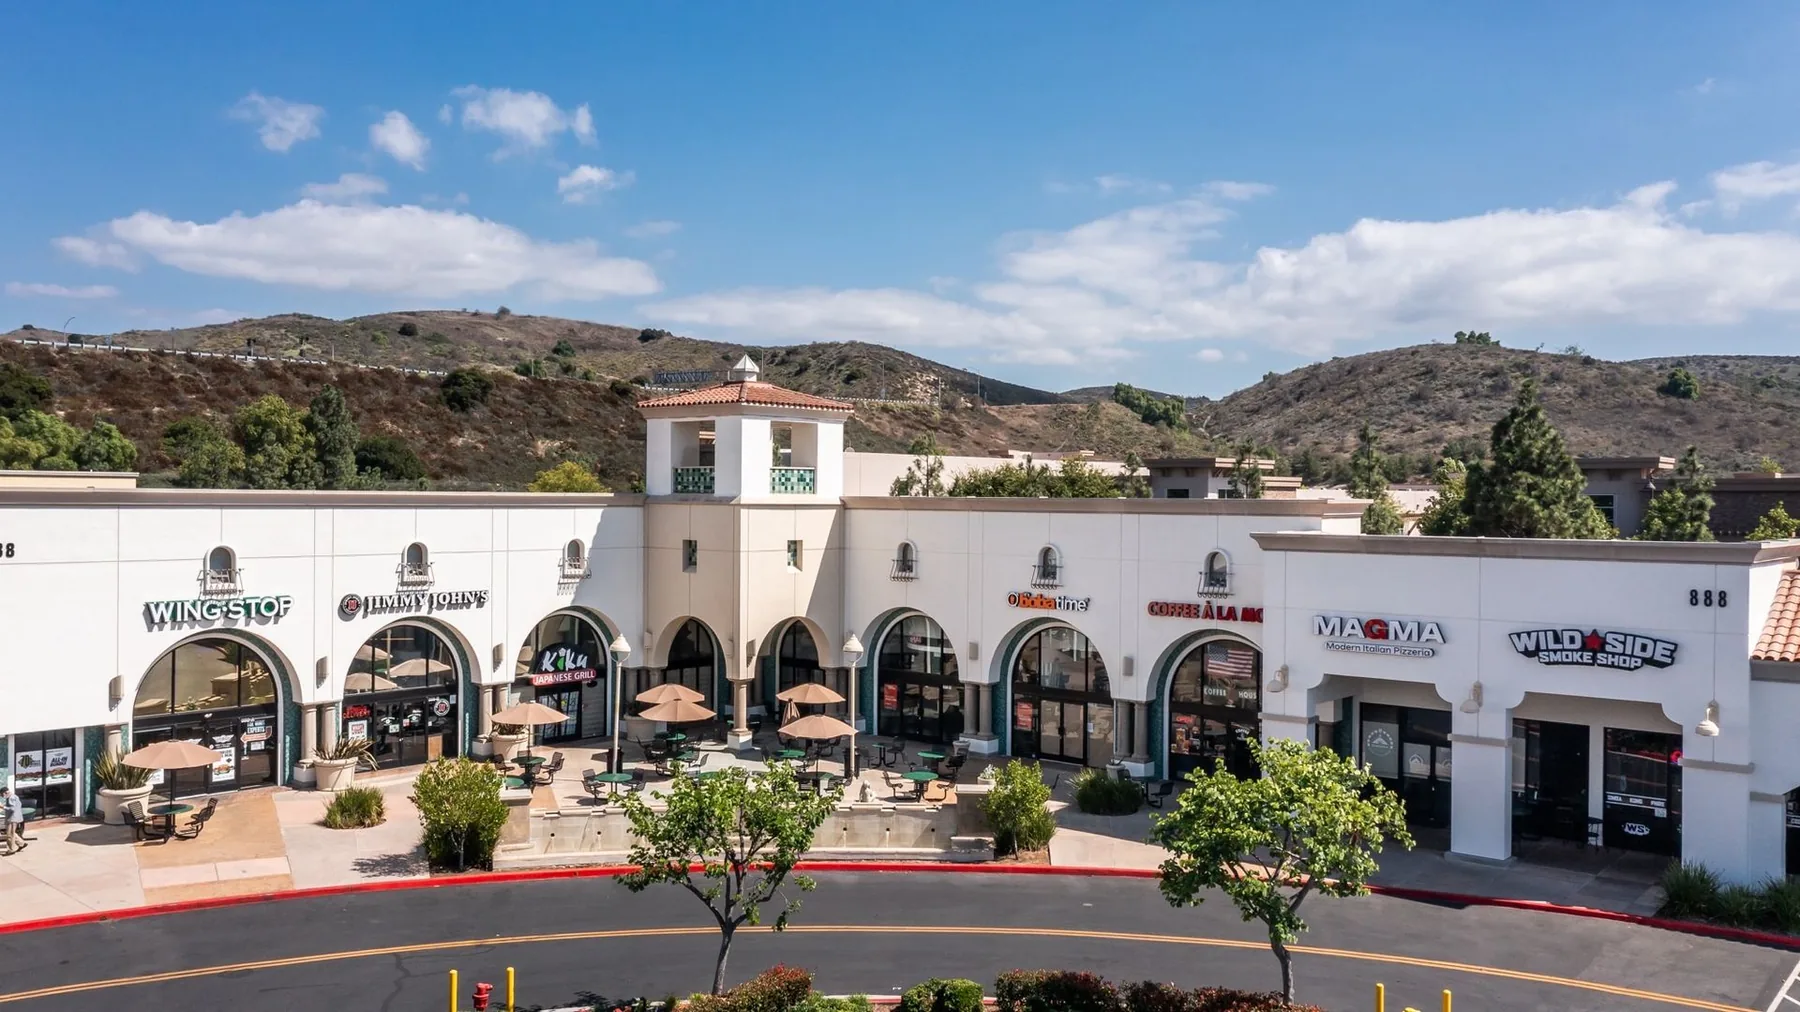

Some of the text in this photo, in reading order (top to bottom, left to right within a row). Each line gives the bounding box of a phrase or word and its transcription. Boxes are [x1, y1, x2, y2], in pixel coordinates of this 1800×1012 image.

[366, 590, 489, 612] JIMMY JOHN'S
[1690, 589, 1727, 608] 888
[1148, 601, 1200, 619] COFFEE
[1216, 605, 1238, 621] LA
[1313, 615, 1446, 643] MAGMA
[1326, 642, 1431, 657] Modern Italian Pizzeria
[1508, 629, 1678, 664] WILD SIDE
[1539, 651, 1642, 669] SMOKE SHOP
[535, 670, 595, 684] JAPANESE GRILL
[1203, 687, 1227, 697] COFFEE
